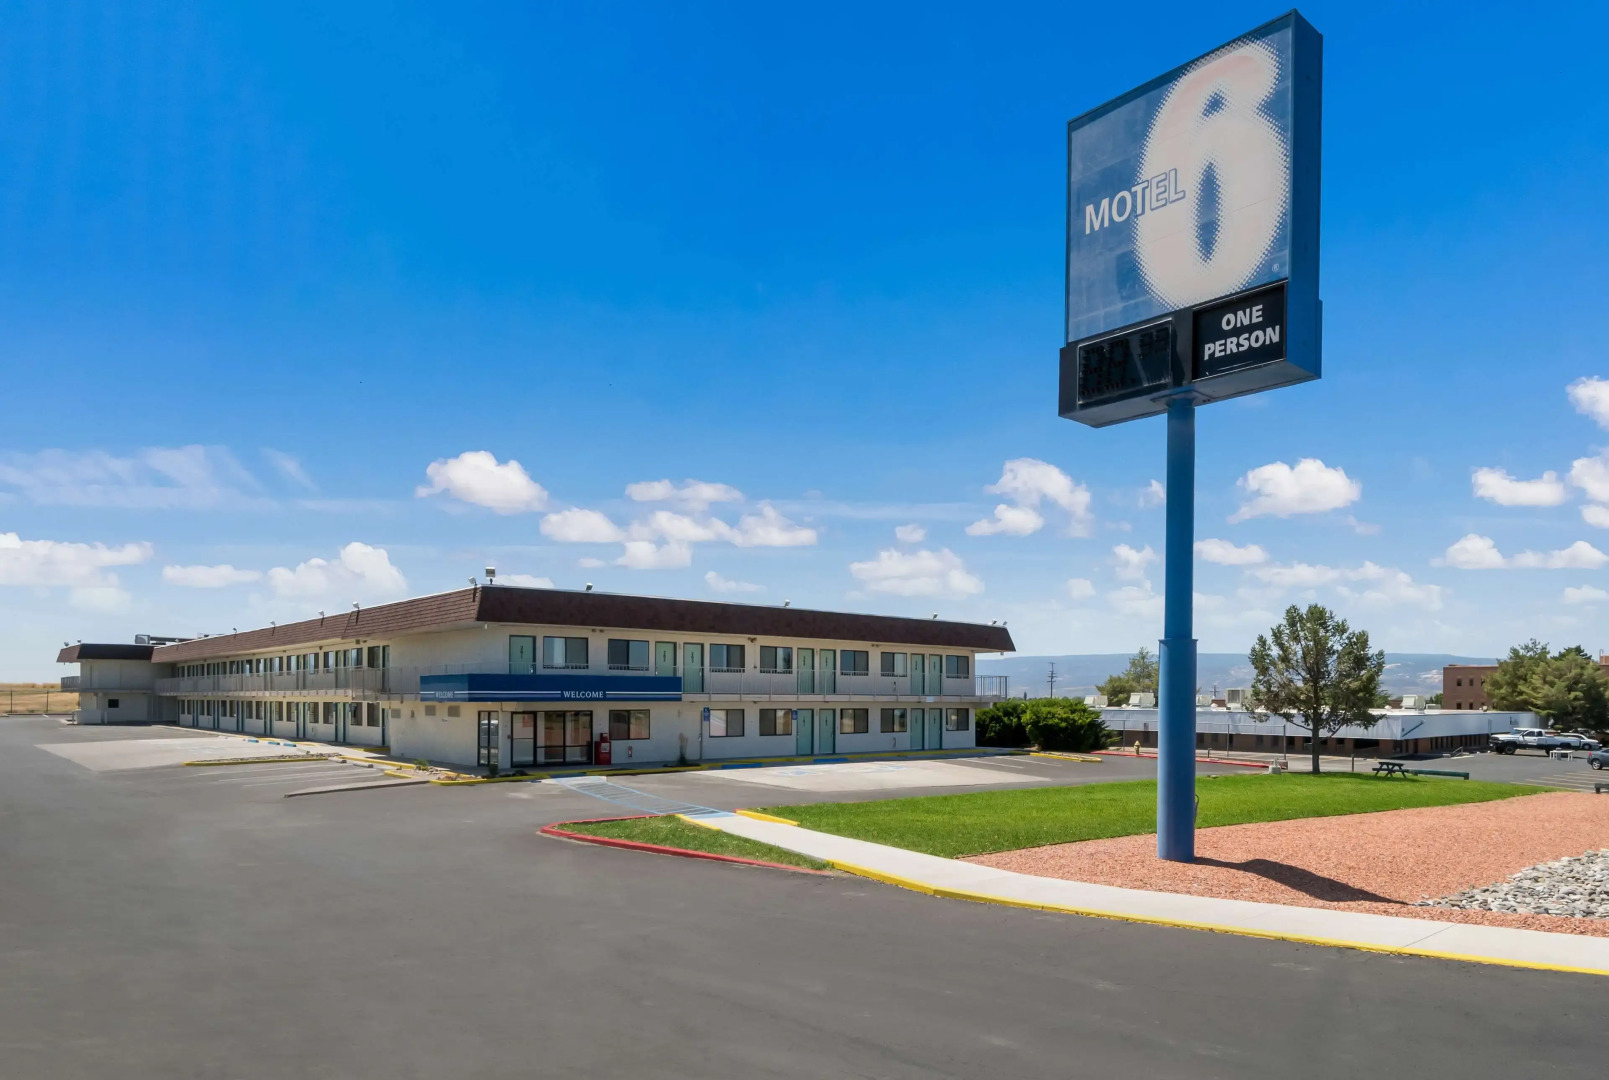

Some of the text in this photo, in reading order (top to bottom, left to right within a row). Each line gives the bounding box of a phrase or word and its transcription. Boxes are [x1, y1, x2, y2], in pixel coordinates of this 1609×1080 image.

[1085, 36, 1289, 312] MOTEL 6
[1221, 304, 1263, 331] ONE
[1203, 325, 1280, 361] PERSON
[563, 690, 604, 699] WELCOME
